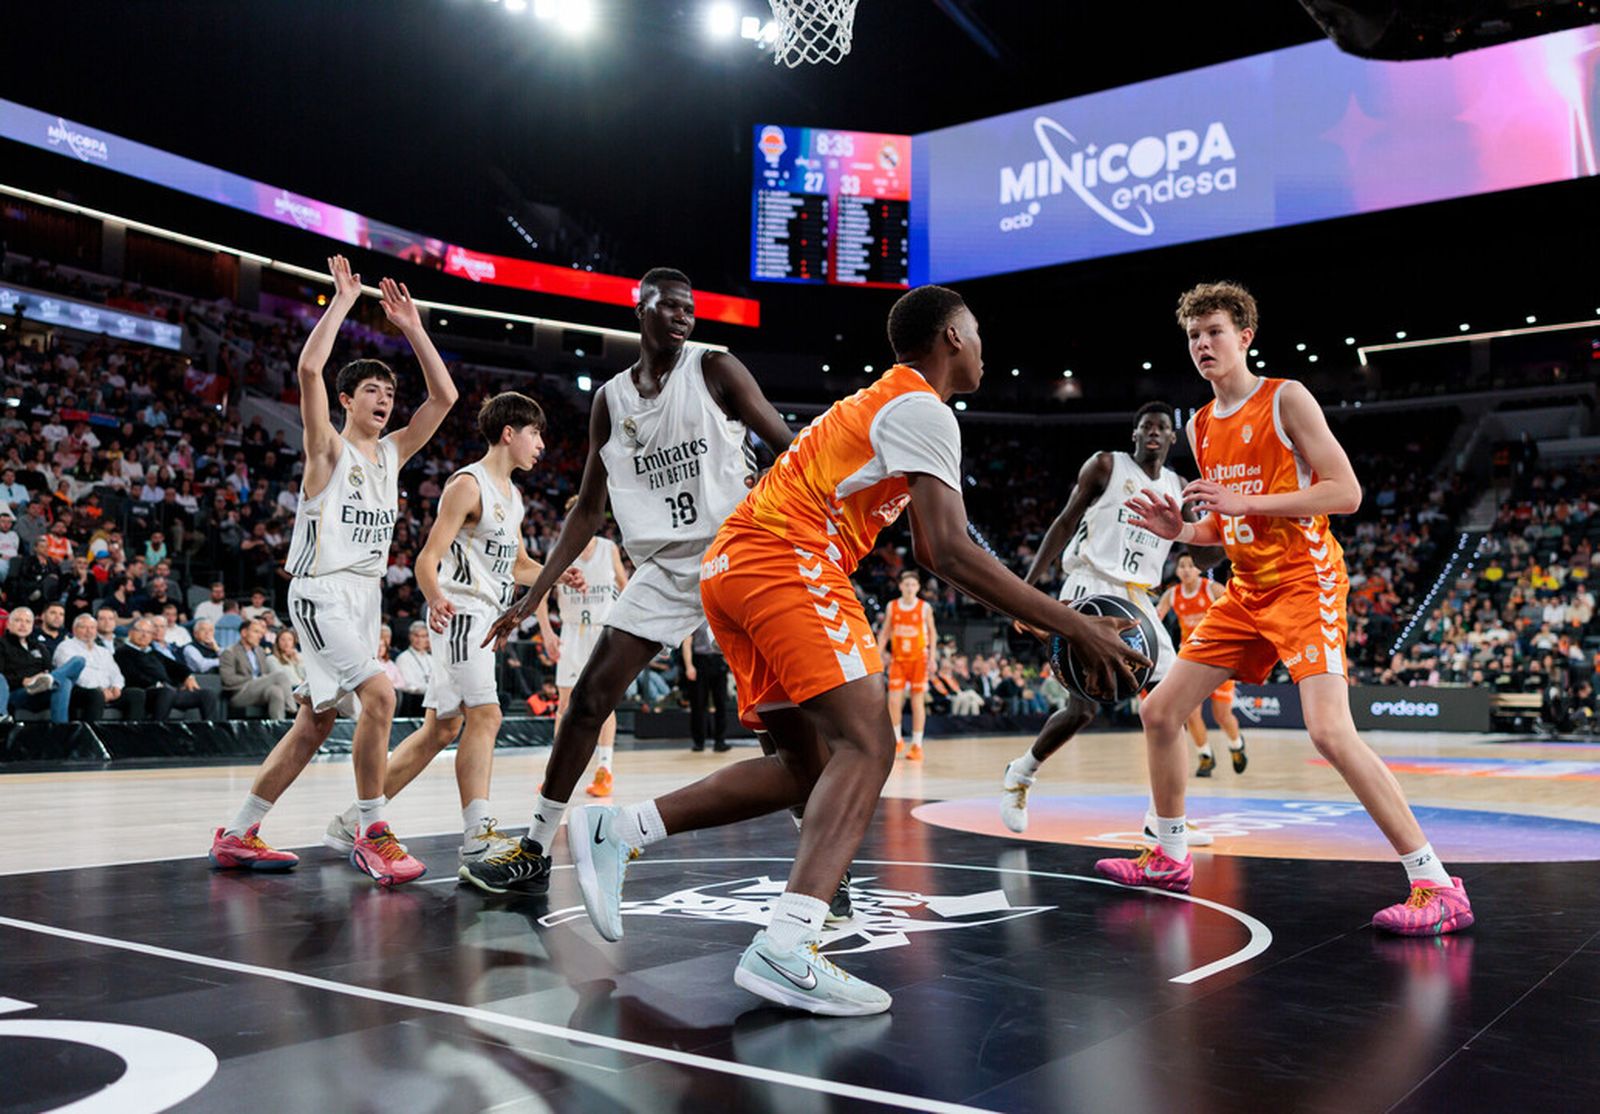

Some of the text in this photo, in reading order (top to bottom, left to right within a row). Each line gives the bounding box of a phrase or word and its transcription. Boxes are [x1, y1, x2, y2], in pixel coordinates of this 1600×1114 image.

[804, 172, 824, 192] 27
[840, 175, 861, 195] 33
[1111, 167, 1237, 210] endesa
[633, 438, 708, 475] Emirates
[1247, 465, 1262, 476] del
[649, 472, 665, 490] FLY
[665, 491, 698, 528] 18
[352, 527, 372, 543] FLY
[1220, 514, 1255, 545] 26
[1122, 548, 1144, 575] 16
[581, 610, 591, 624] 8
[1370, 700, 1439, 716] endesa
